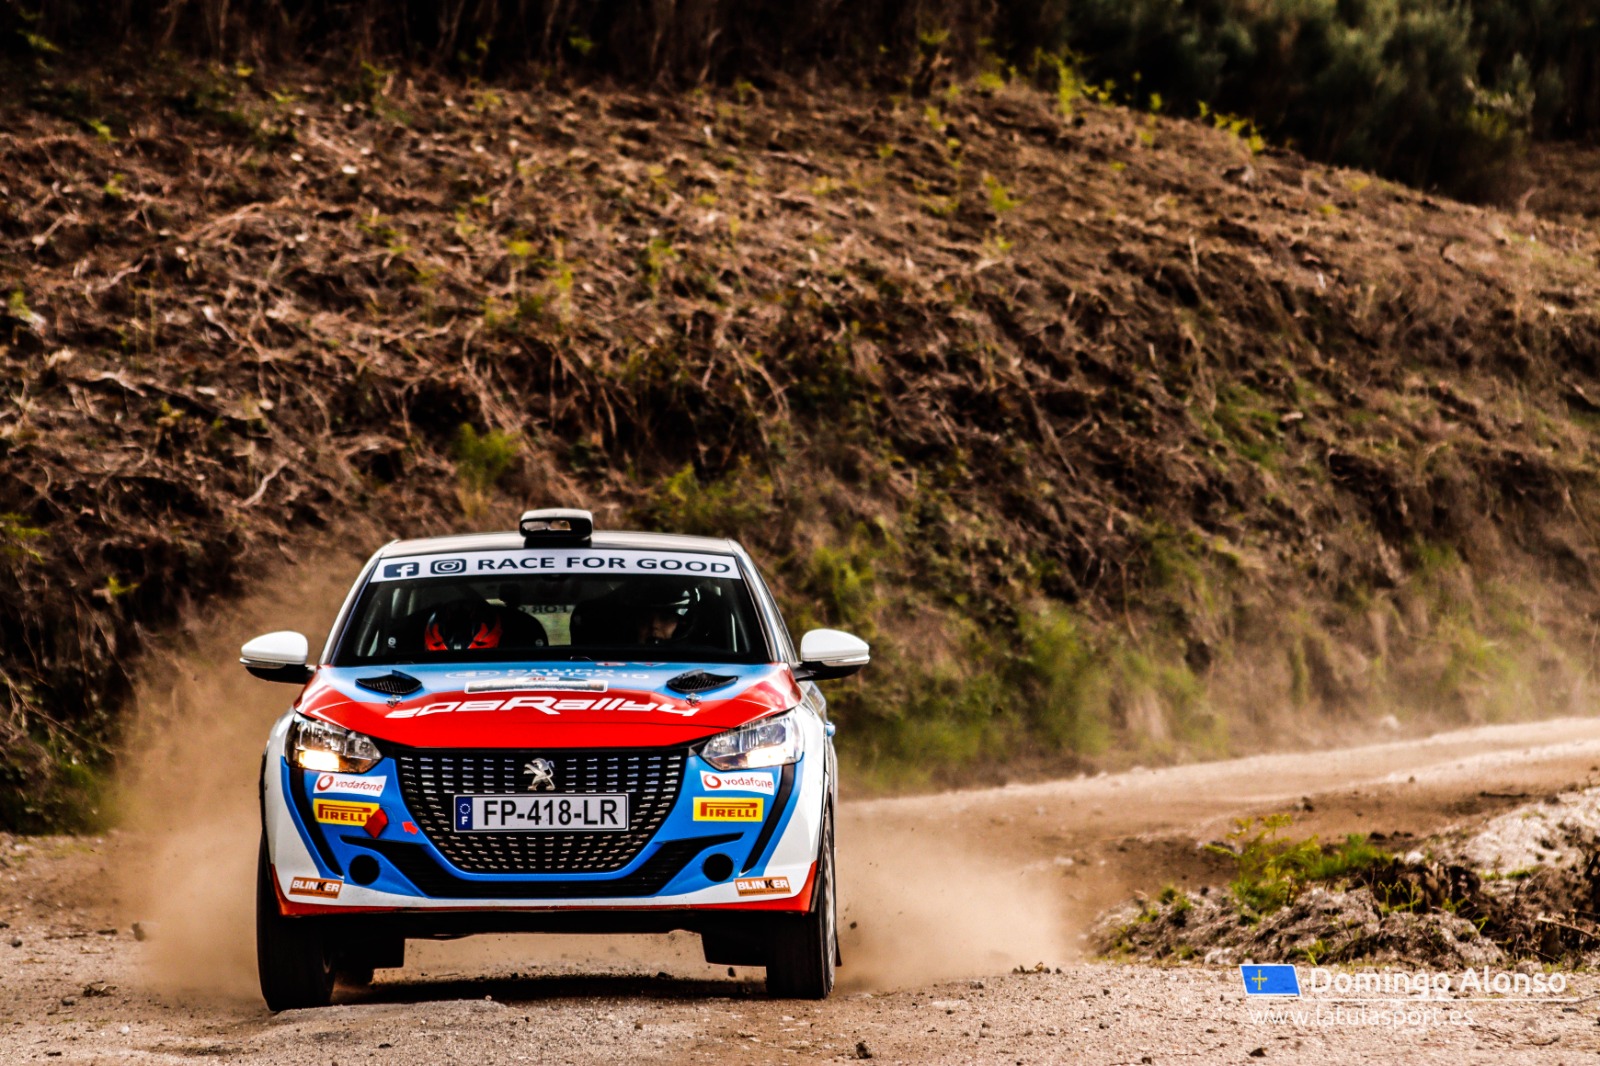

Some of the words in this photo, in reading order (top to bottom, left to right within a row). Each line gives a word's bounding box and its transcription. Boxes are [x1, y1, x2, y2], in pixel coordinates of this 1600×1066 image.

[478, 557, 555, 570] RACE
[566, 557, 626, 569] FOR
[636, 558, 730, 573] GOOD
[335, 780, 383, 792] vodafone
[724, 777, 773, 788] vodafone
[484, 799, 618, 826] FP-418-LR
[700, 802, 758, 818] PIRELLI
[461, 817, 468, 825] F
[292, 880, 340, 892] BLINKER
[736, 879, 788, 890] BLINKER
